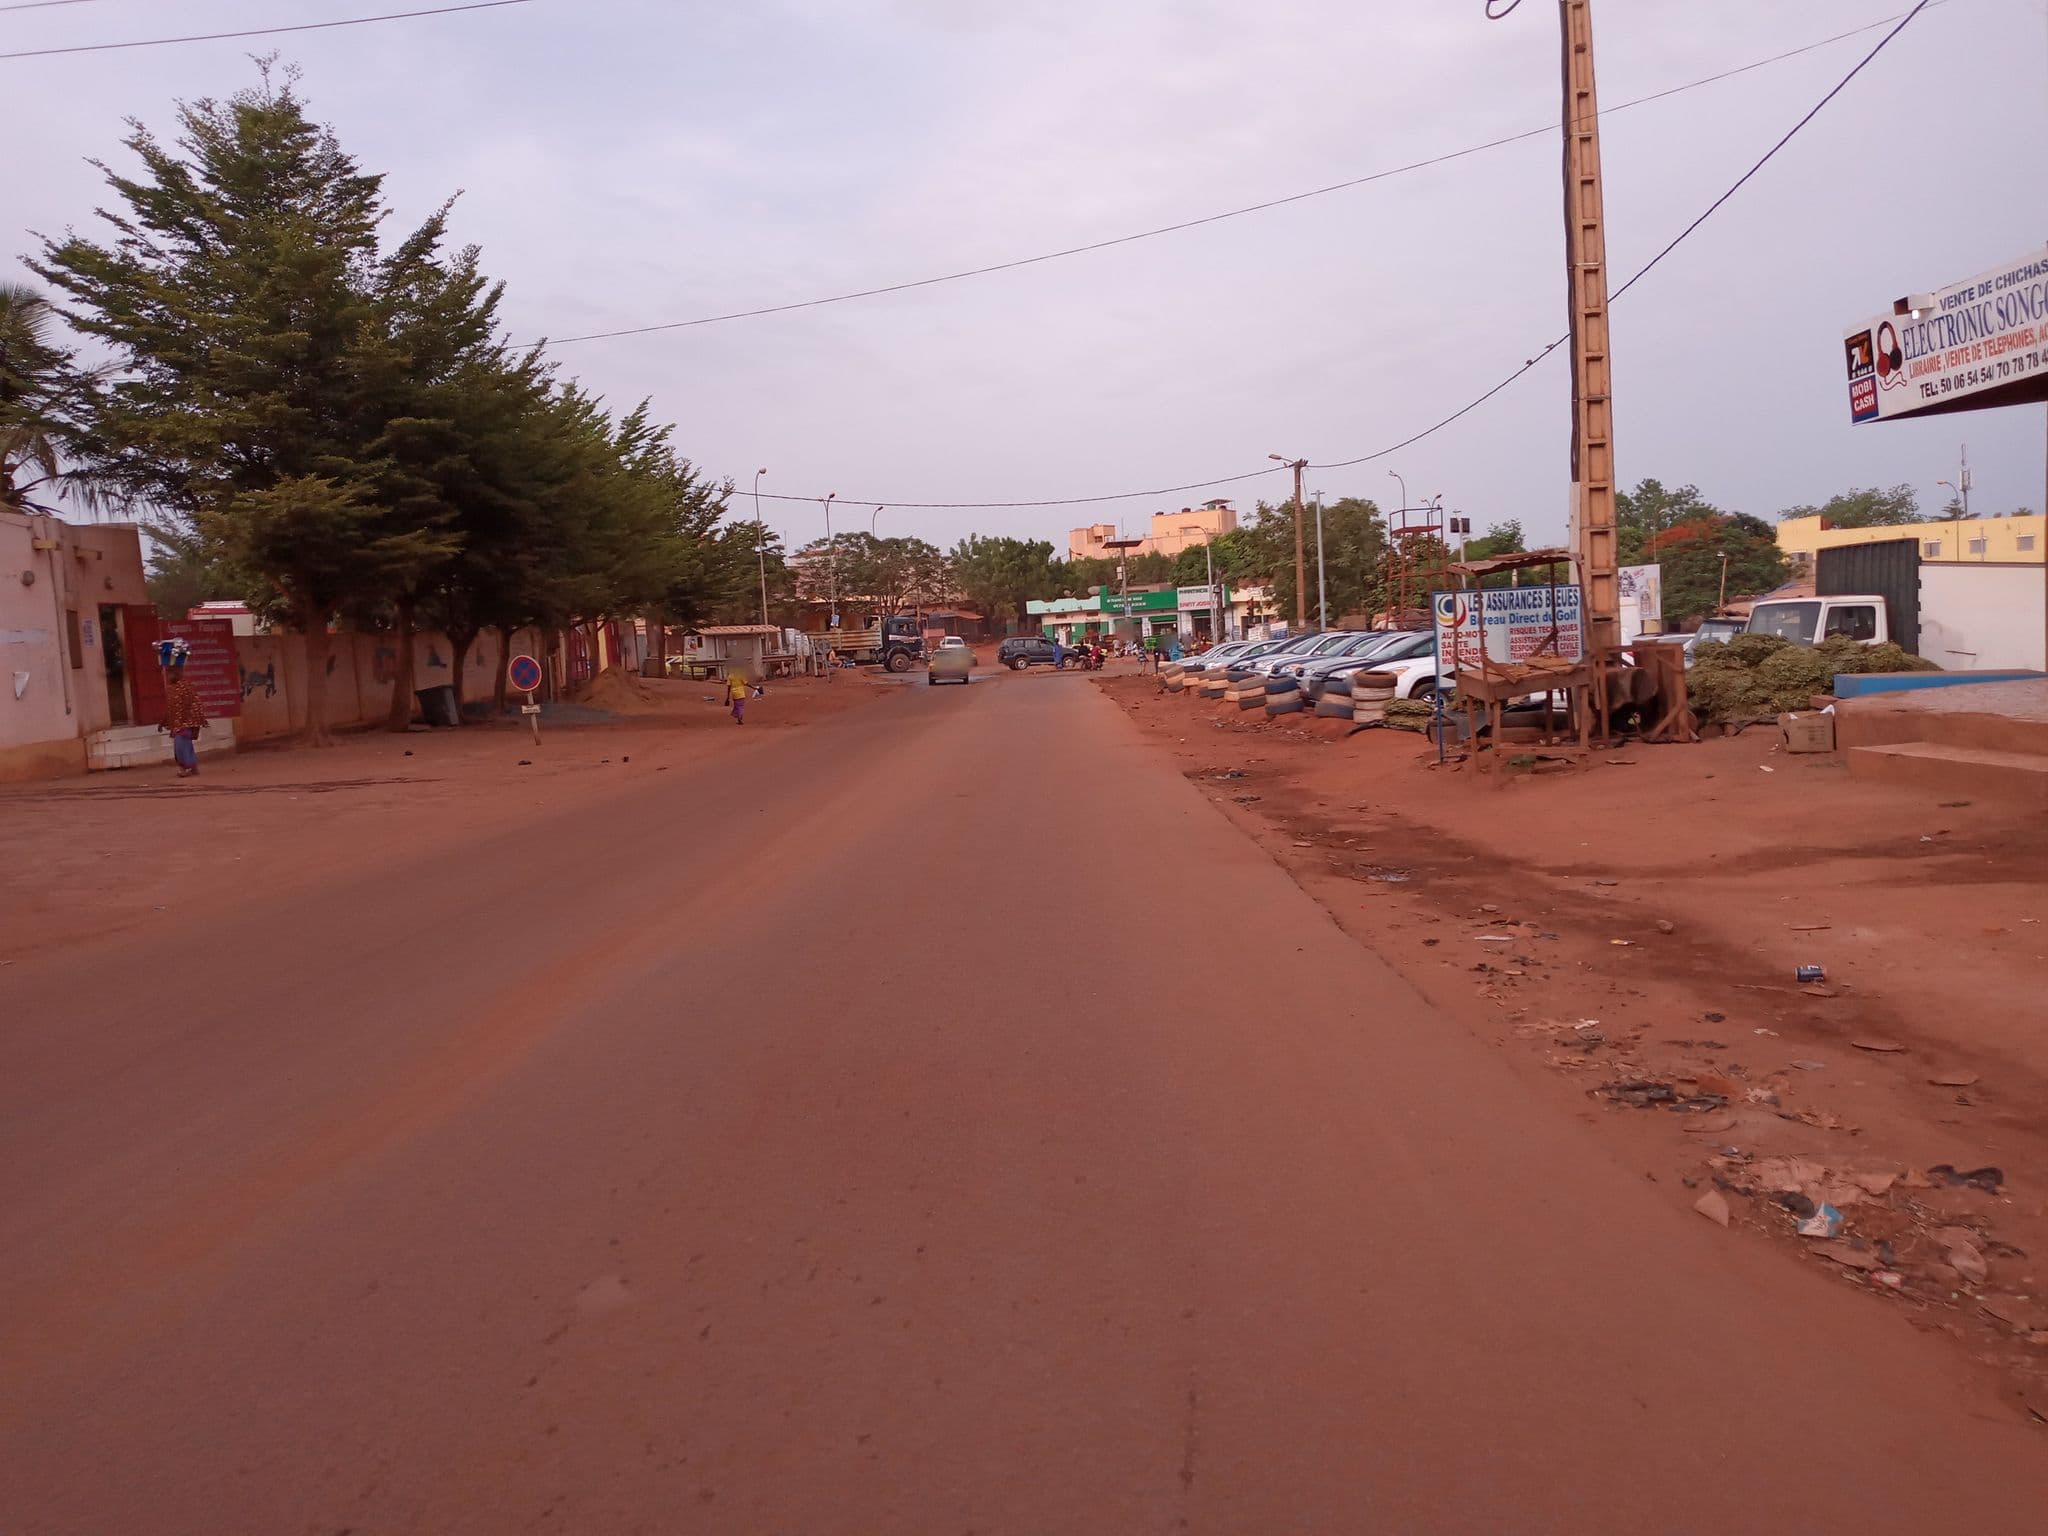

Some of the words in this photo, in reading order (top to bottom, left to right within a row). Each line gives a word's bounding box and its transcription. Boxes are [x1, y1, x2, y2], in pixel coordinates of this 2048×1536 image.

[1940, 287, 1975, 311] VENTE
[1978, 280, 1993, 297] DE
[1902, 302, 1994, 360] ELECTRONIC
[1909, 355, 1942, 379] LIBRAIRIE
[1972, 346, 1982, 361] DE
[1920, 383, 1939, 399] TEL:
[1941, 375, 1951, 393] 50
[1954, 373, 1965, 390] 06
[1967, 369, 1978, 387] 54
[1997, 360, 2010, 379] 70
[2012, 356, 2024, 375] 78
[2026, 351, 2039, 370] 78
[1852, 379, 1873, 397] MOBI
[1854, 393, 1875, 412] CASH
[1486, 589, 1543, 612] ASSURANCES
[1546, 588, 1579, 608] BEUES
[1470, 614, 1505, 626] Breau
[1509, 612, 1540, 624] Direct
[1557, 609, 1577, 621] Golf
[1538, 624, 1578, 634] TECIQUES
[1441, 641, 1469, 649] SATE
[1442, 647, 1488, 657] INENDE
